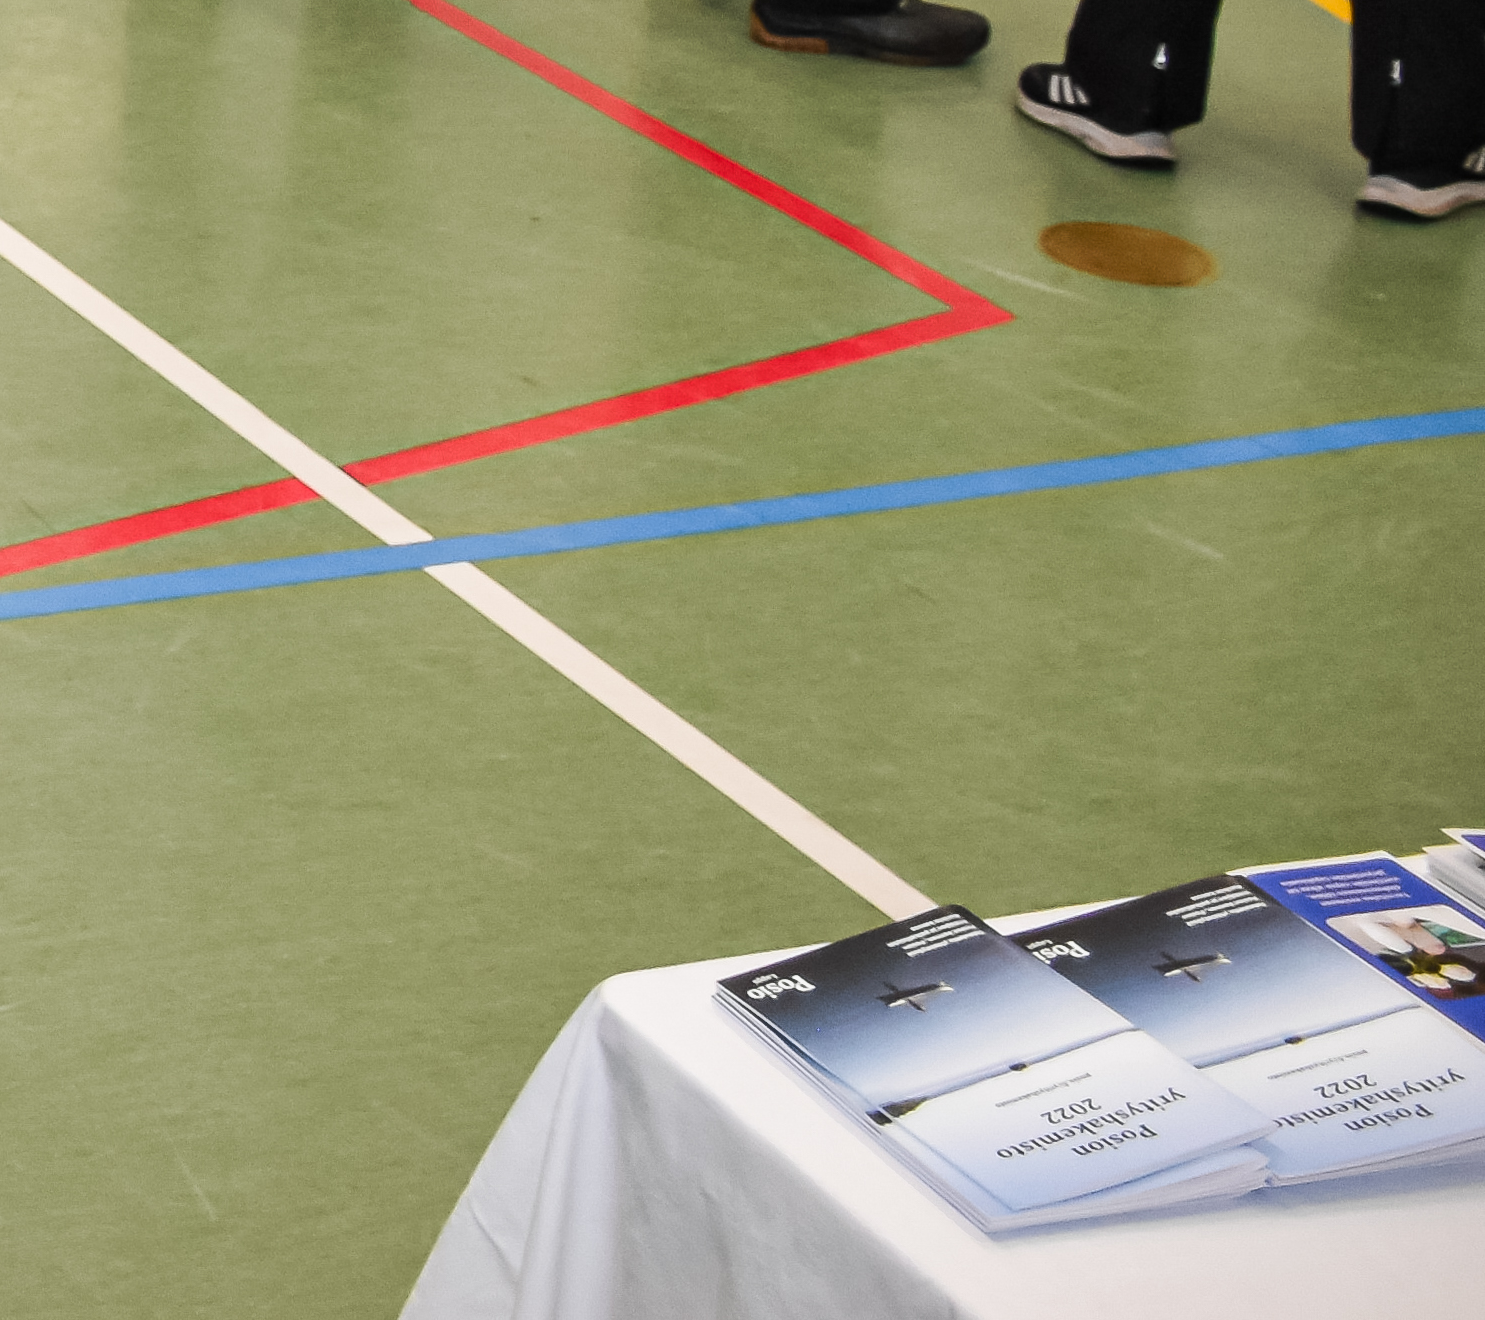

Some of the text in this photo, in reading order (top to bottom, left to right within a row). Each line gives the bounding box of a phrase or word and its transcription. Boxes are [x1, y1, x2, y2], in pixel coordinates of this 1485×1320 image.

[1032, 939, 1091, 964] Posi
[747, 974, 817, 1001] Posio
[1313, 1072, 1378, 1100] 2022
[996, 1087, 1186, 1160] yrityshakemisto
[1041, 1097, 1102, 1125] 2022
[1344, 1103, 1434, 1132] Posion
[1071, 1124, 1158, 1158] Posion
